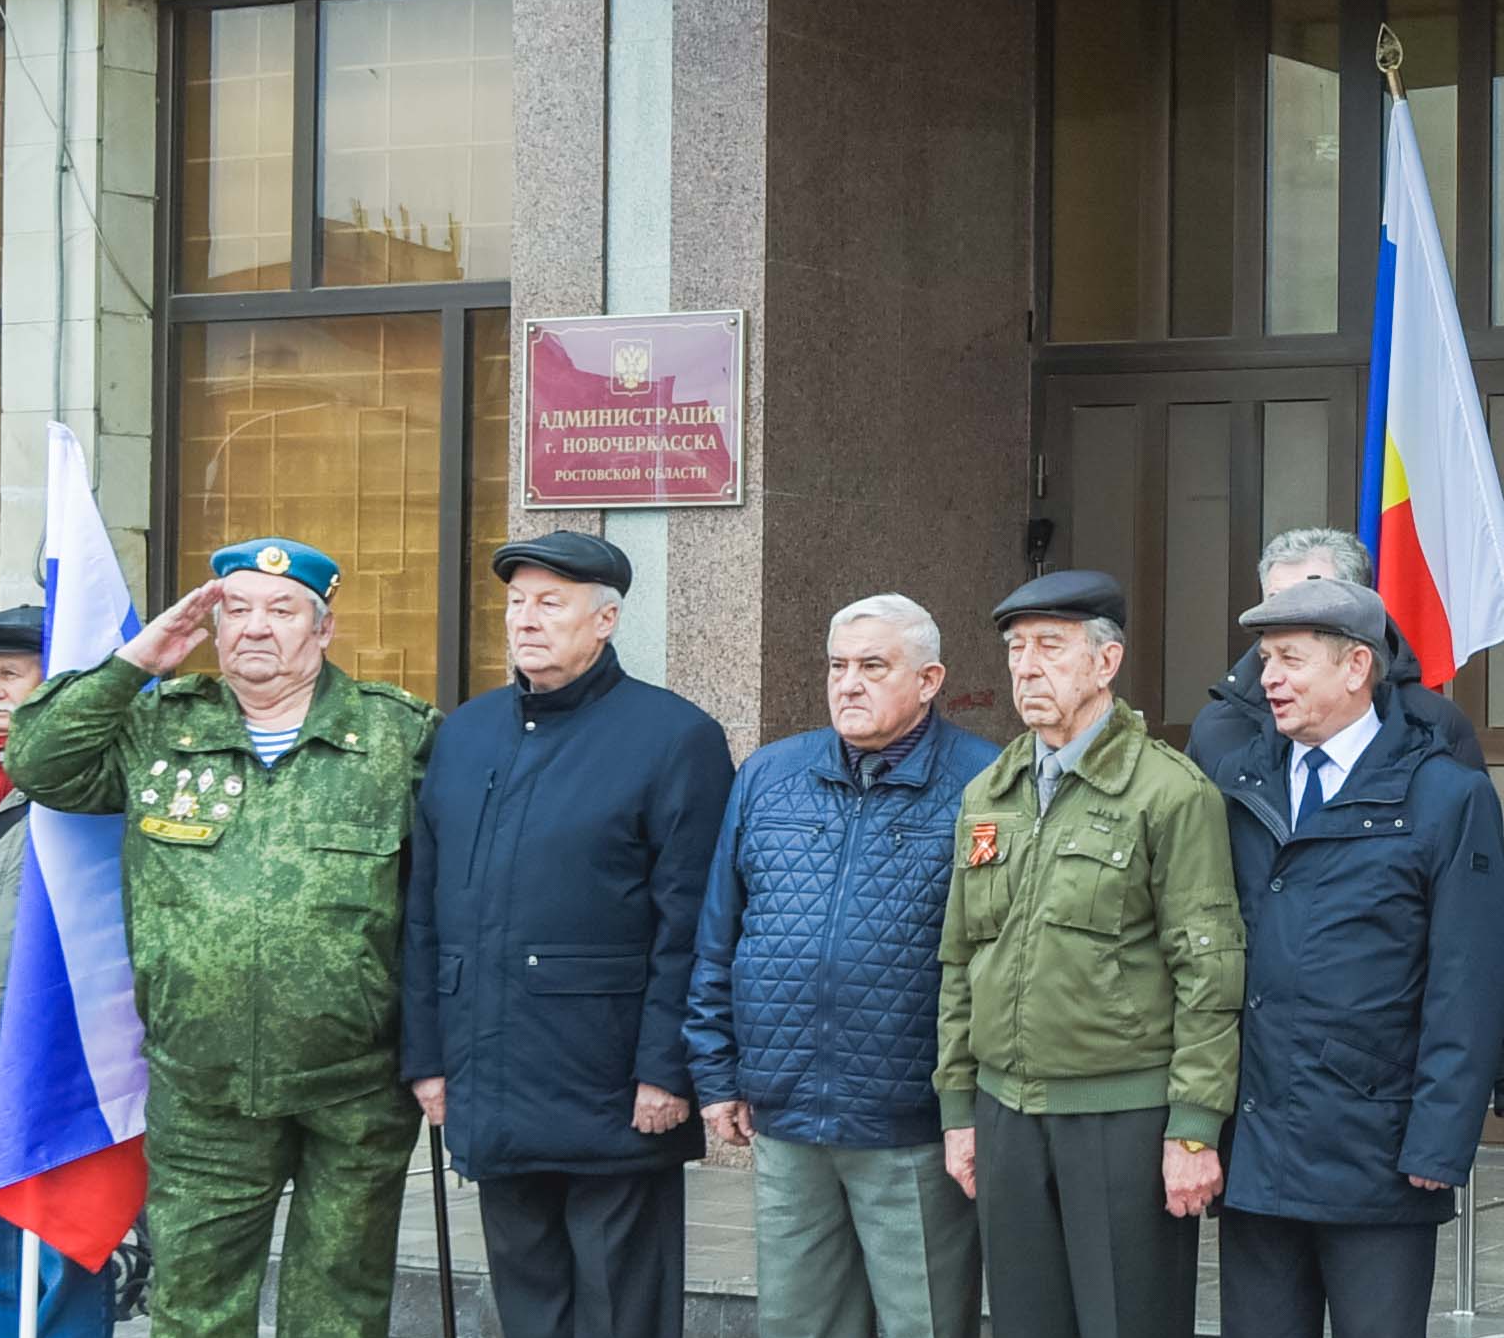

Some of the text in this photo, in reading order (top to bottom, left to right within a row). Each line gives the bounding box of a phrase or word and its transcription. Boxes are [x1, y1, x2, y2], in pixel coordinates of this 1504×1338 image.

[538, 405, 727, 431] АДМИНИСТРАЦИЯ
[545, 434, 718, 454] г. НОВОЧЕРКАССКА
[554, 466, 708, 482] РОСТОВСКОЙ ОБЛАСТИ
